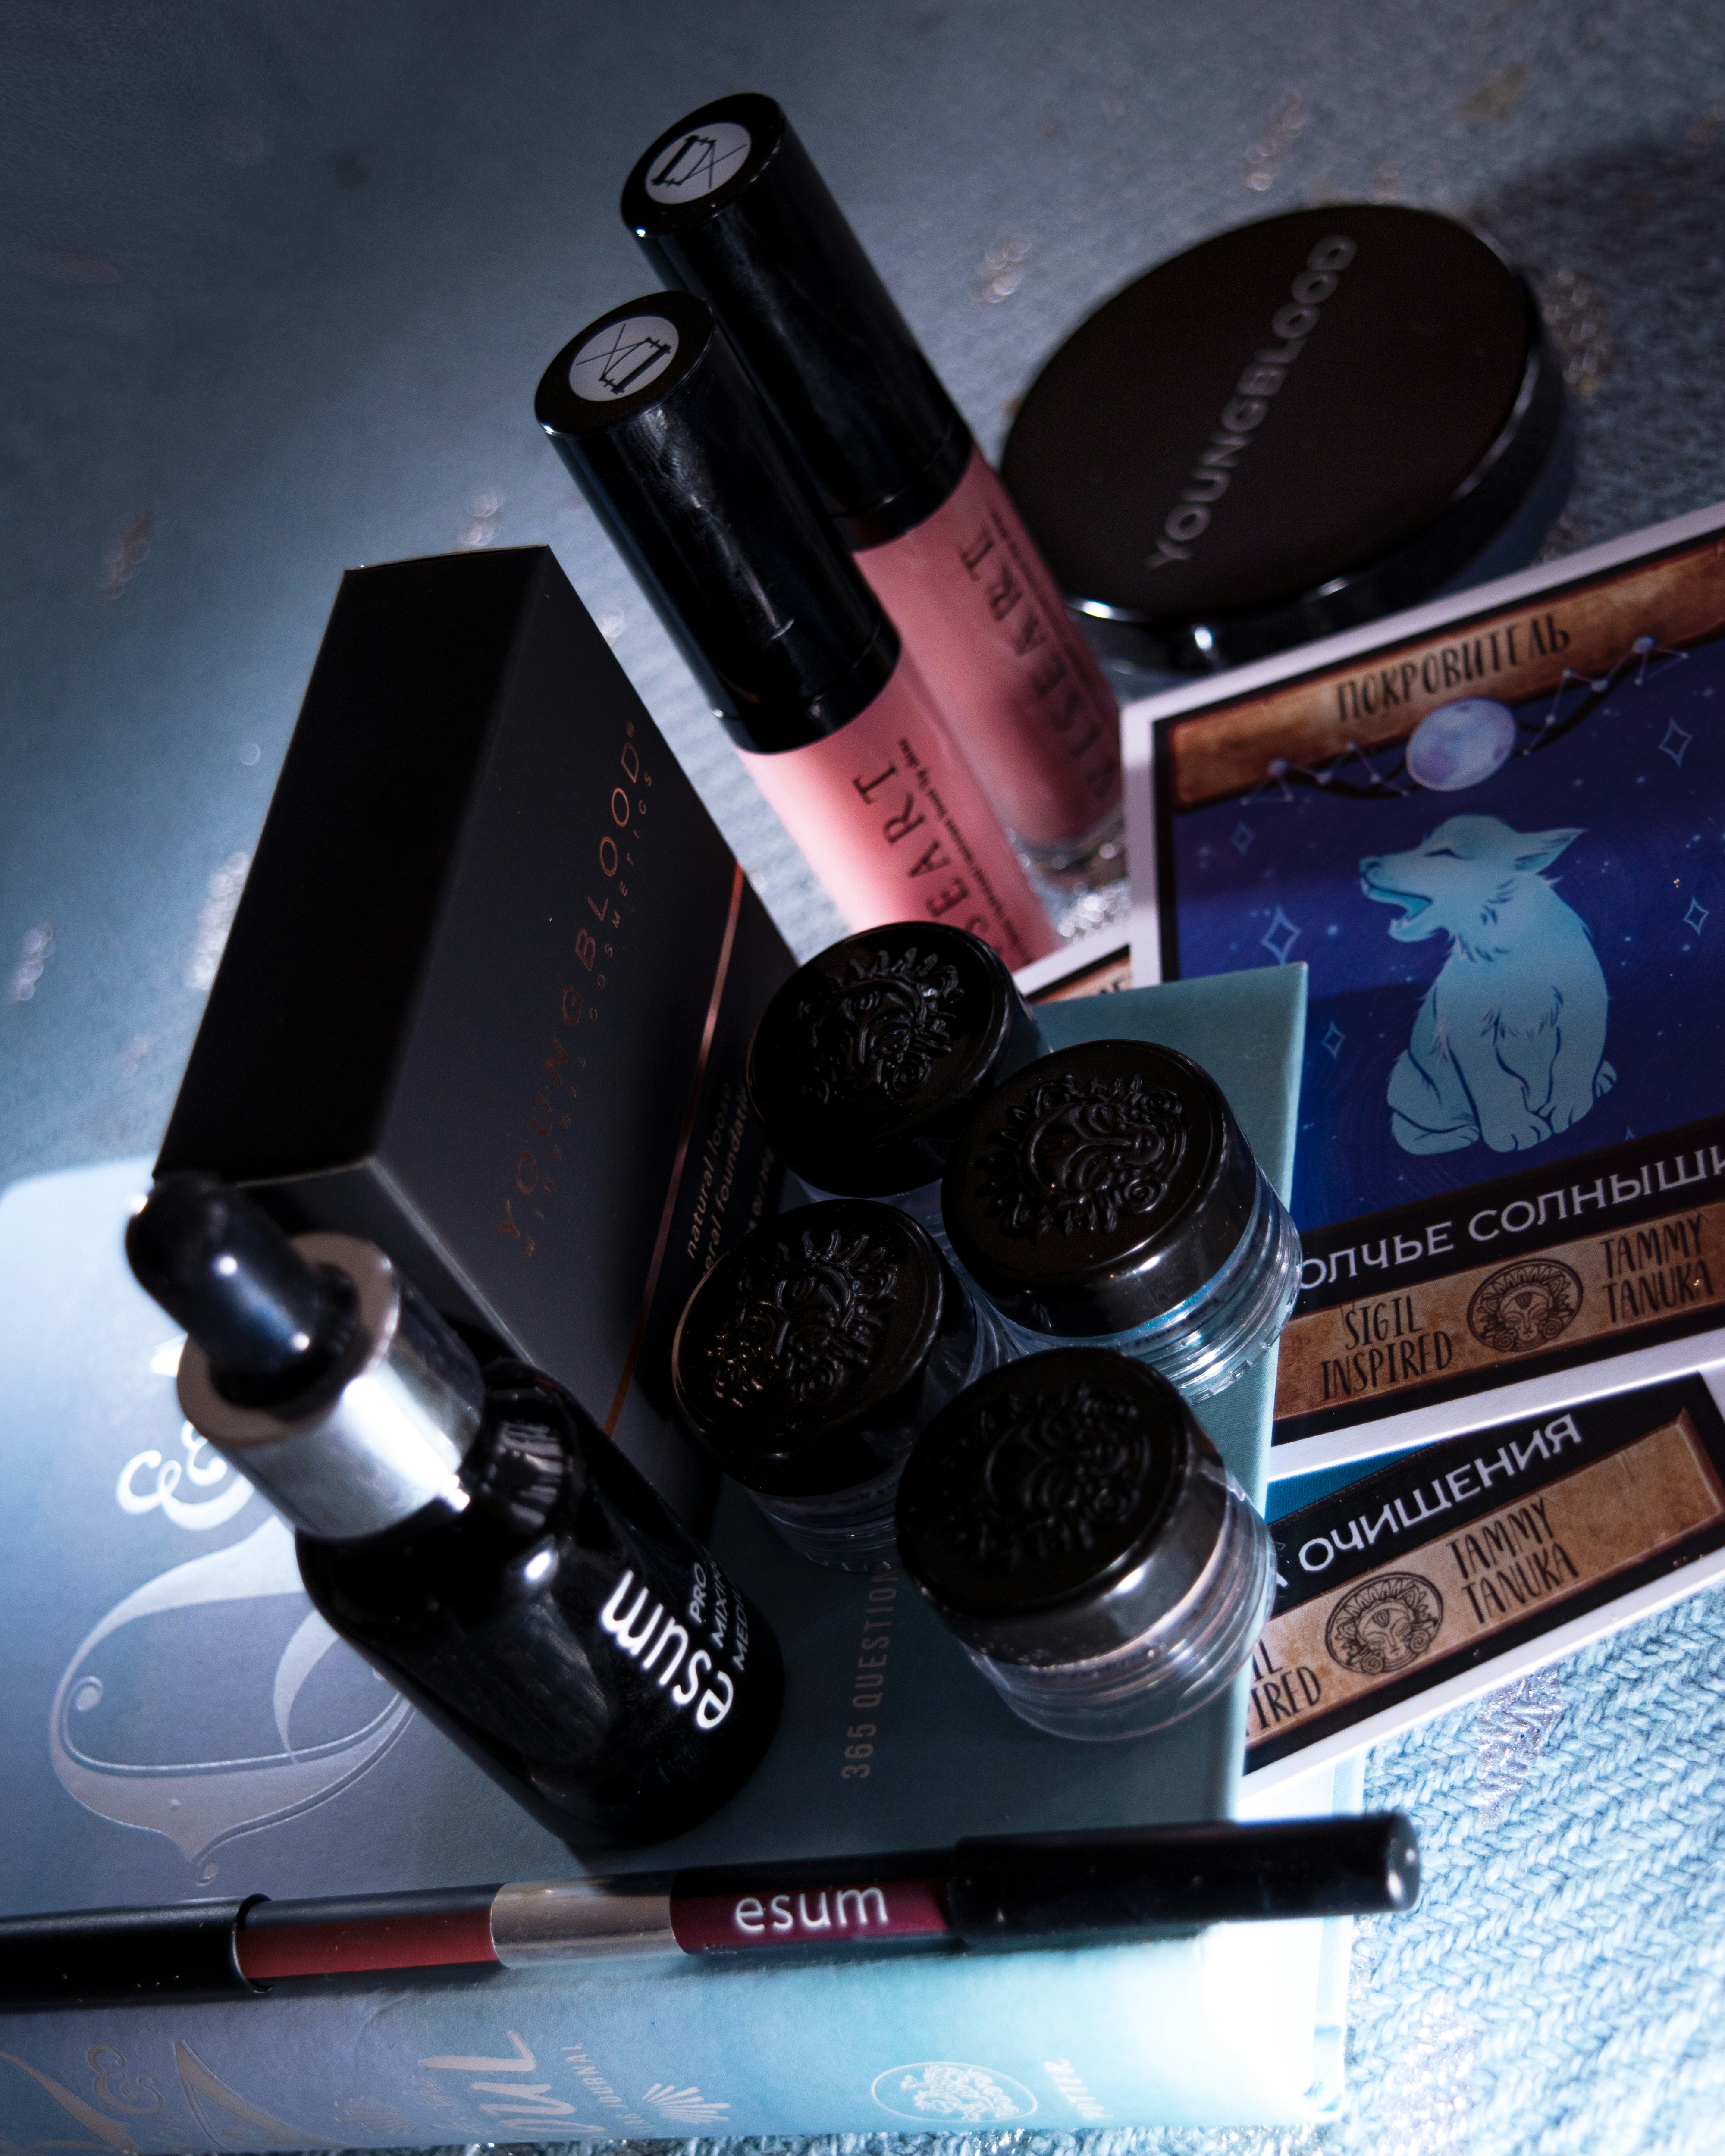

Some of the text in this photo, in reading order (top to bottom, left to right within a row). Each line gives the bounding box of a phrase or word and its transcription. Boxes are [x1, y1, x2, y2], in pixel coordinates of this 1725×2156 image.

[1145, 234, 1358, 569] YOUNGBLOOD
[1336, 614, 1570, 723] ПОКРОВИТЕЛЬ
[589, 771, 652, 1021] COSMETICS
[687, 1081, 732, 1259] natural loose
[702, 1215, 722, 1275] eral
[1300, 1221, 1454, 1290] ОЛЧЬЕ
[1600, 1213, 1704, 1278] TAMMY
[1344, 1294, 1423, 1350] SIGIL
[1603, 1259, 1715, 1324] TANUKA
[1321, 1331, 1453, 1400] INSPIRED
[1298, 1413, 1582, 1572] ОЧИЩЕНИЯ
[1447, 1497, 1555, 1580] TAMMY
[690, 1561, 707, 1624] PRO
[1462, 1542, 1580, 1624] TANUKA
[599, 1567, 735, 1730] esum
[841, 1723, 877, 1780] 365
[734, 1886, 888, 1931] esum
[561, 2042, 630, 2109] JOURNAL
